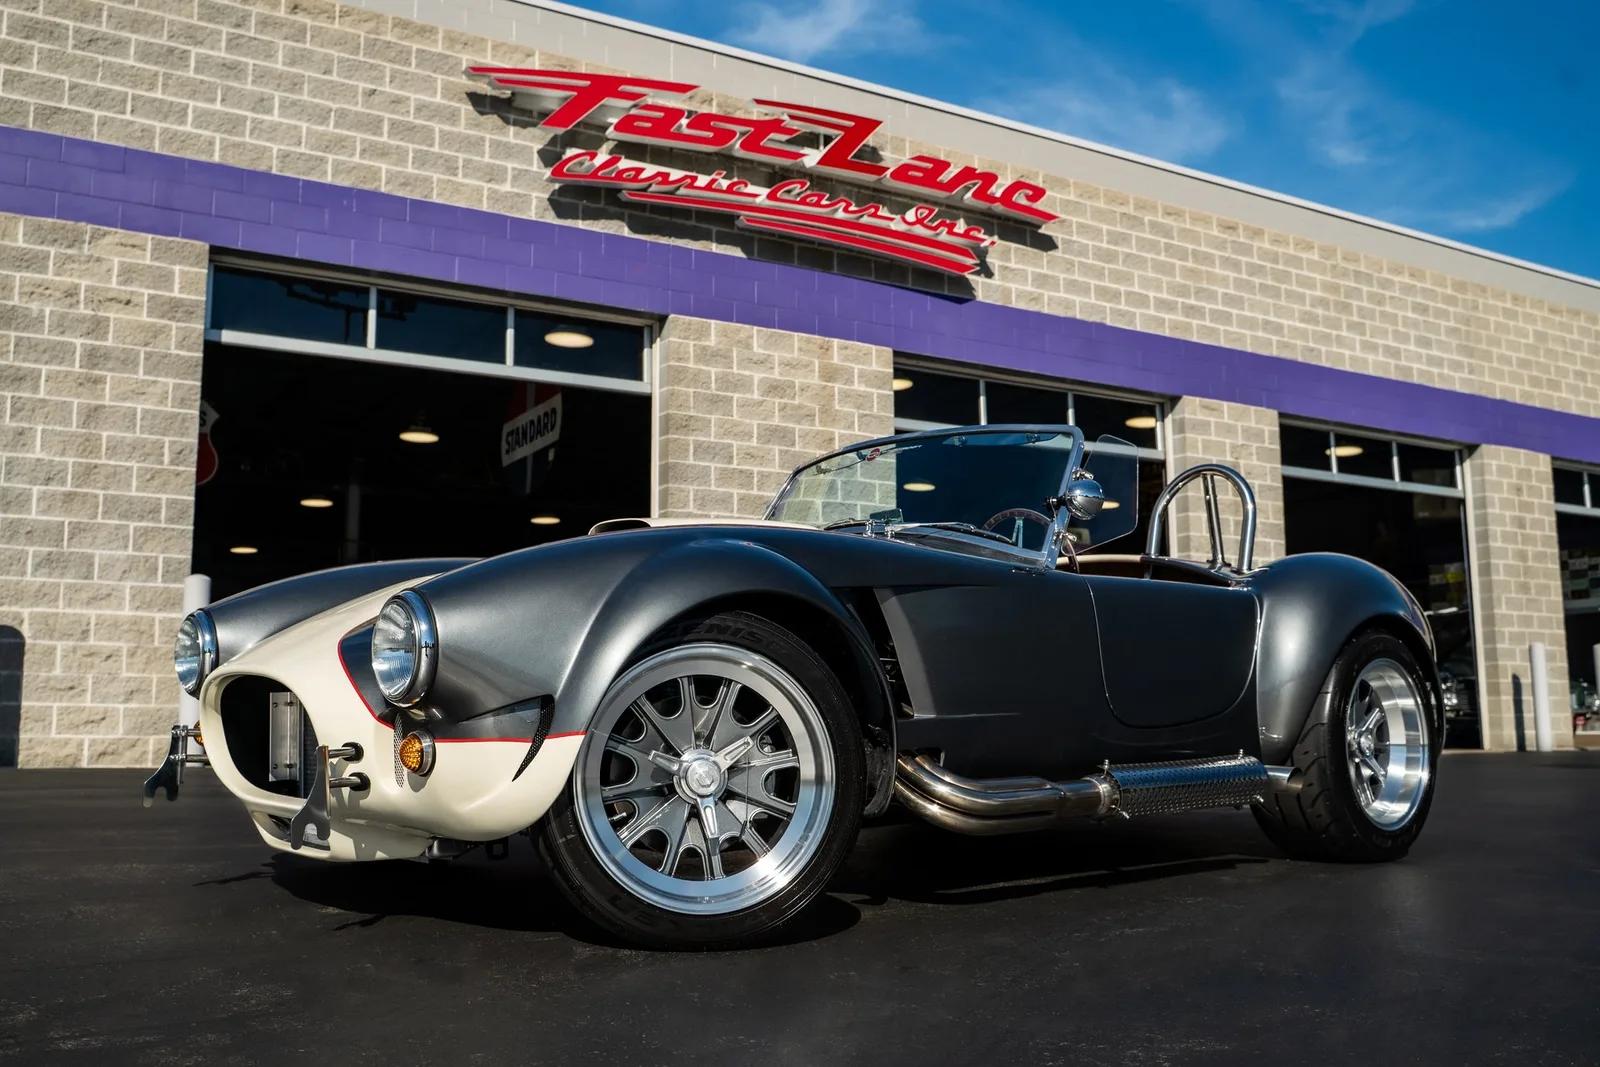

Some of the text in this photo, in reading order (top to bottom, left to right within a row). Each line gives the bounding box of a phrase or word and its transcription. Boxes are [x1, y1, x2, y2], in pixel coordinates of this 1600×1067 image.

[549, 150, 762, 199] Classic
[766, 179, 897, 222] Cars
[505, 407, 557, 455] STANDARD
